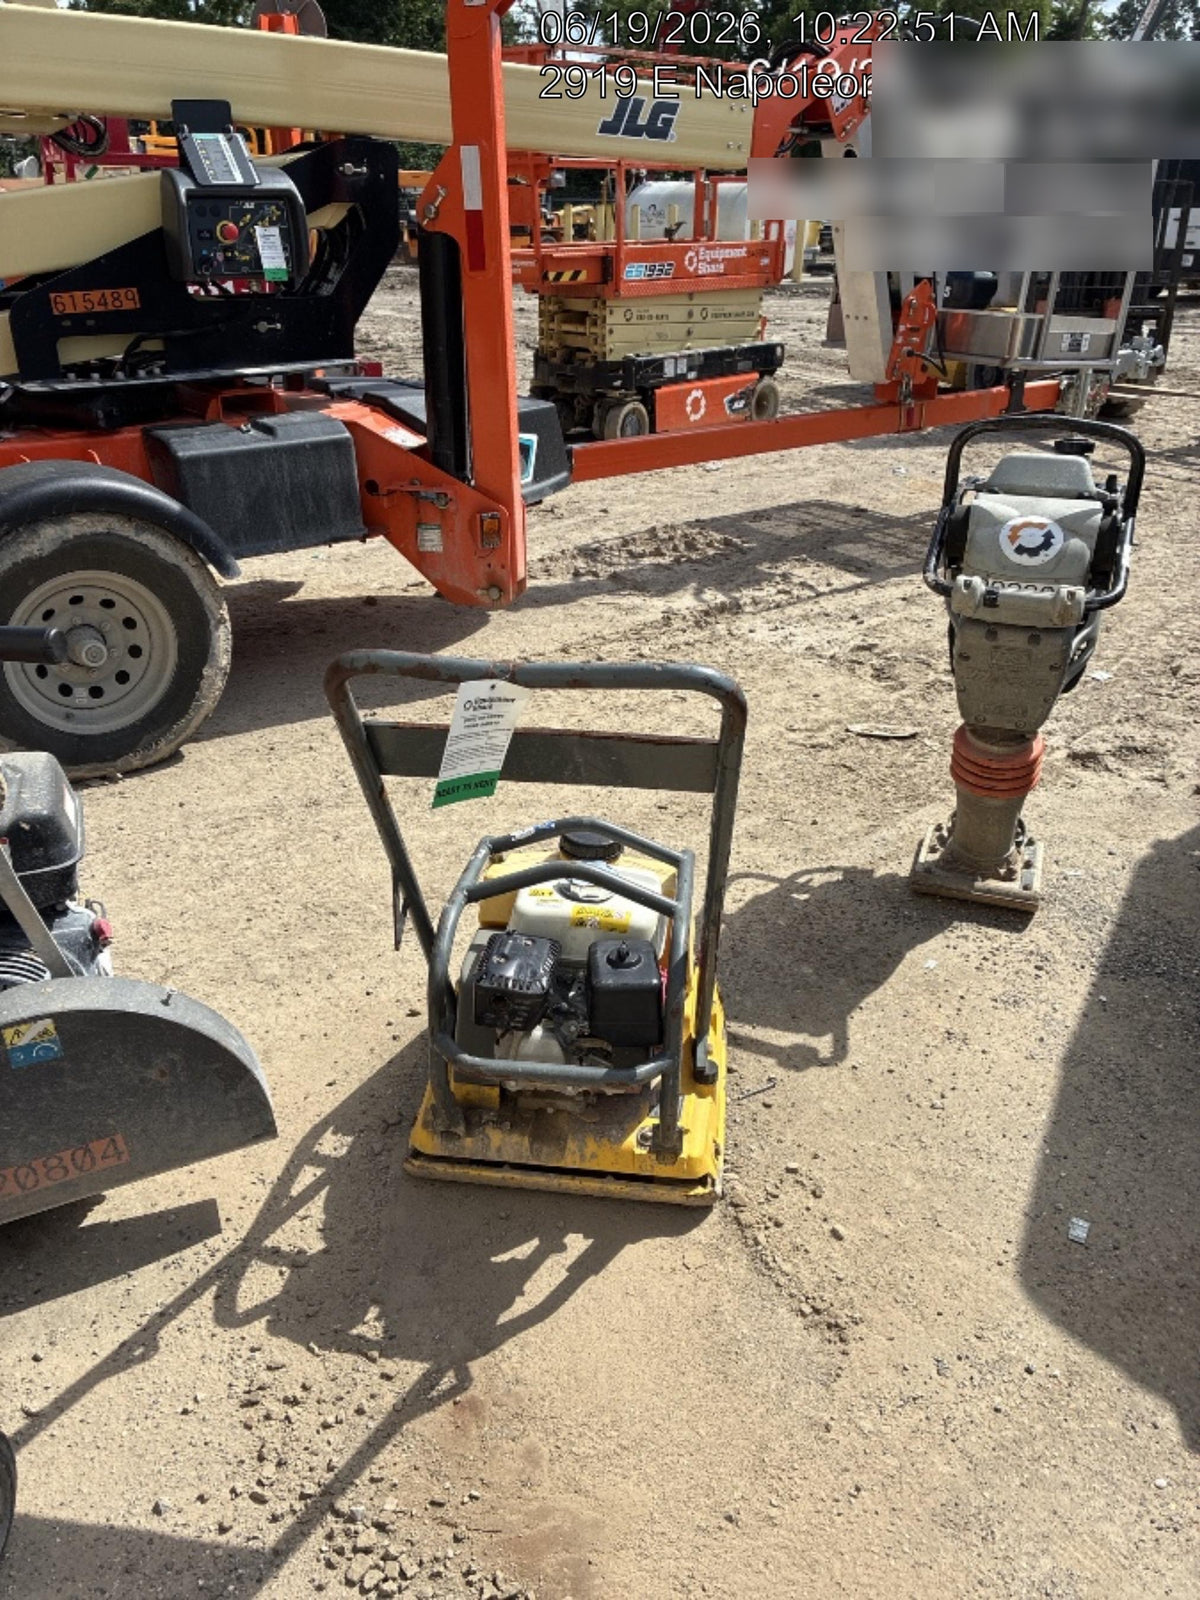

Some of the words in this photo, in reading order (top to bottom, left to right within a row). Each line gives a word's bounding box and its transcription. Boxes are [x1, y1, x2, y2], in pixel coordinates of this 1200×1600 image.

[597, 97, 682, 142] JLG
[625, 261, 676, 280] ES1932
[53, 289, 137, 314] 615489
